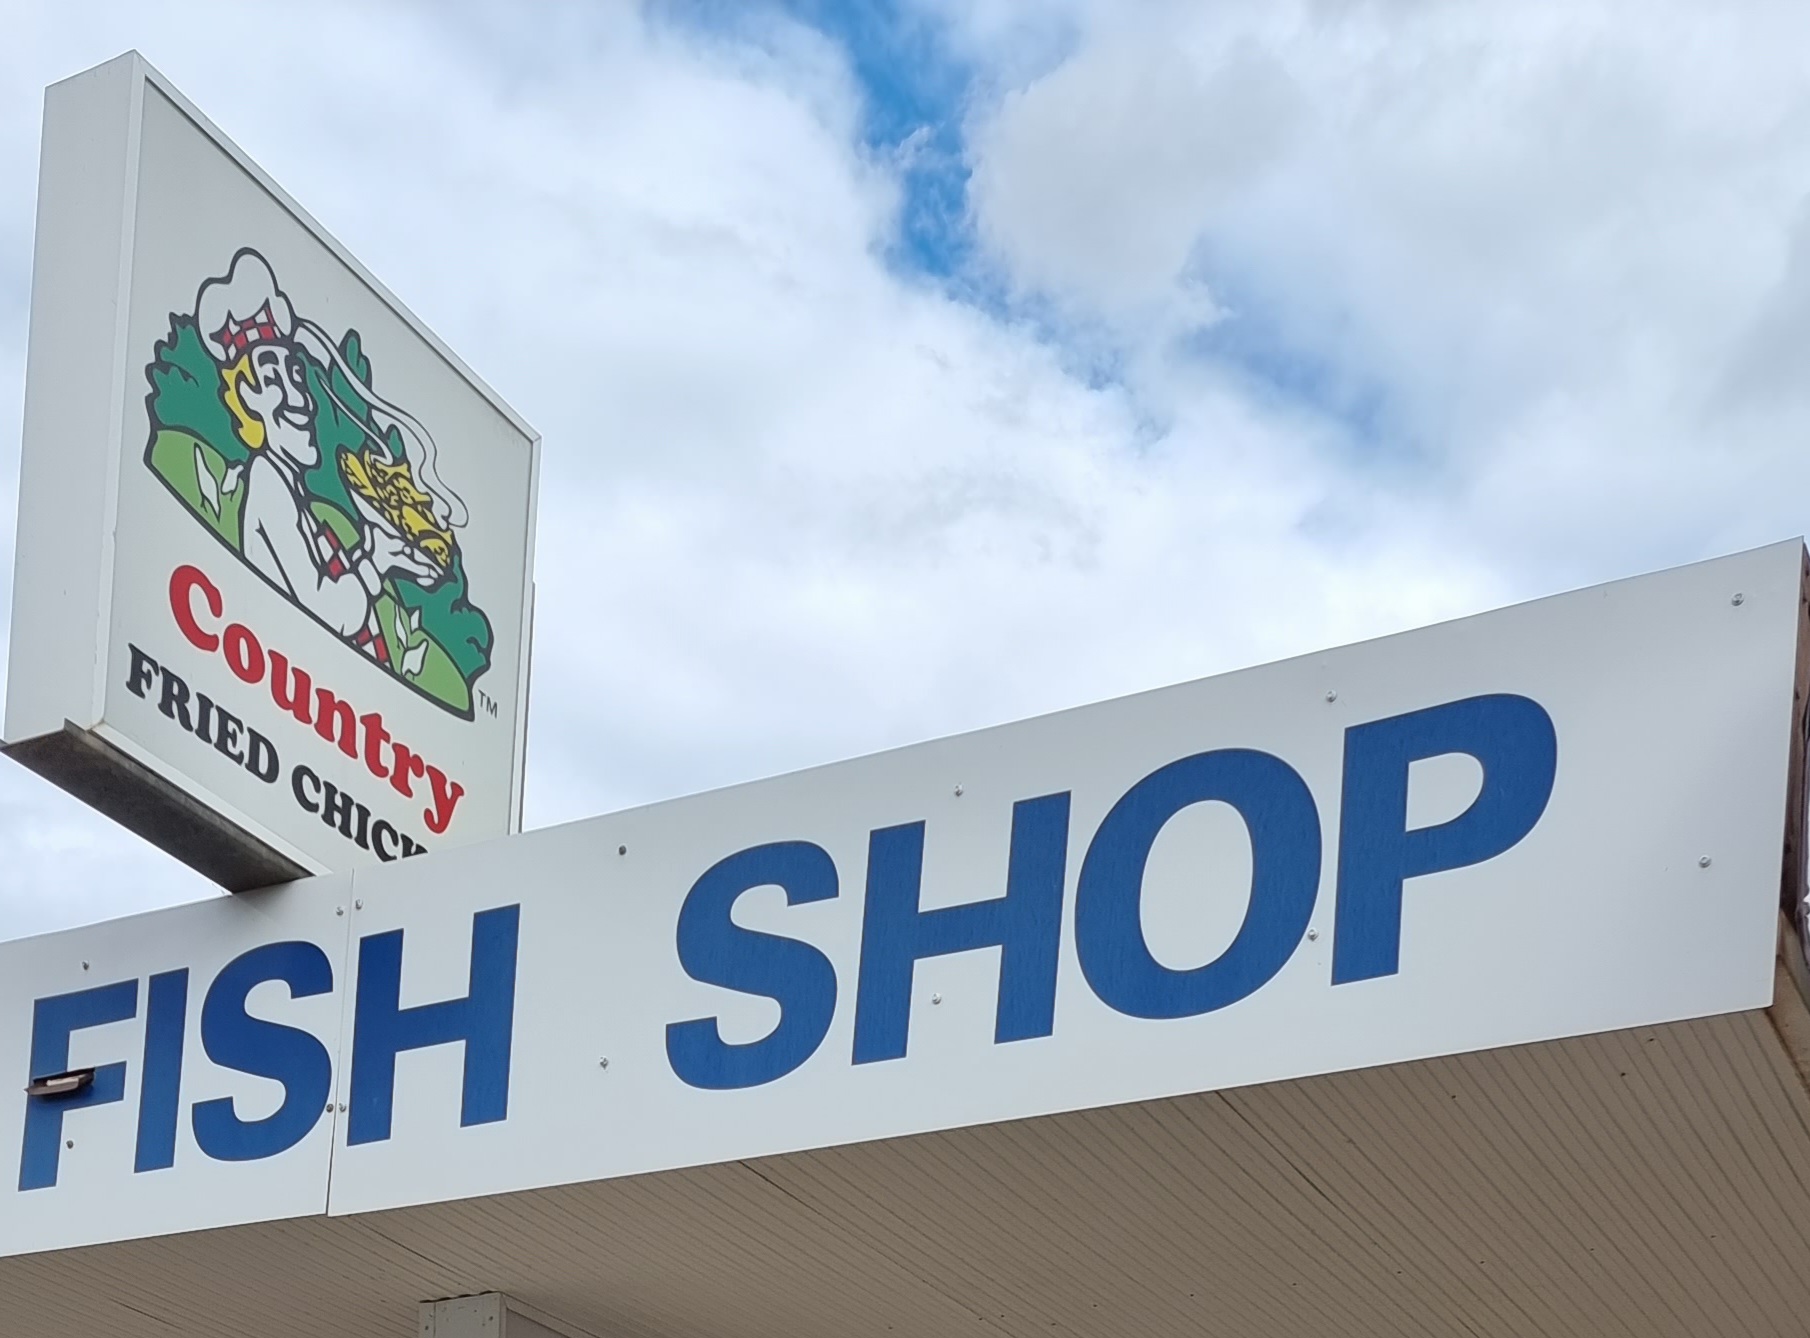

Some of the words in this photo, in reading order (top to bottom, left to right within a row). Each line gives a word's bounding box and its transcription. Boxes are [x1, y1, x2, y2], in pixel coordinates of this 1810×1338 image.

[126, 643, 280, 784] FRIED
[169, 565, 464, 834] Country
[18, 903, 520, 1192] FISH
[666, 693, 1557, 1090] SHOP
